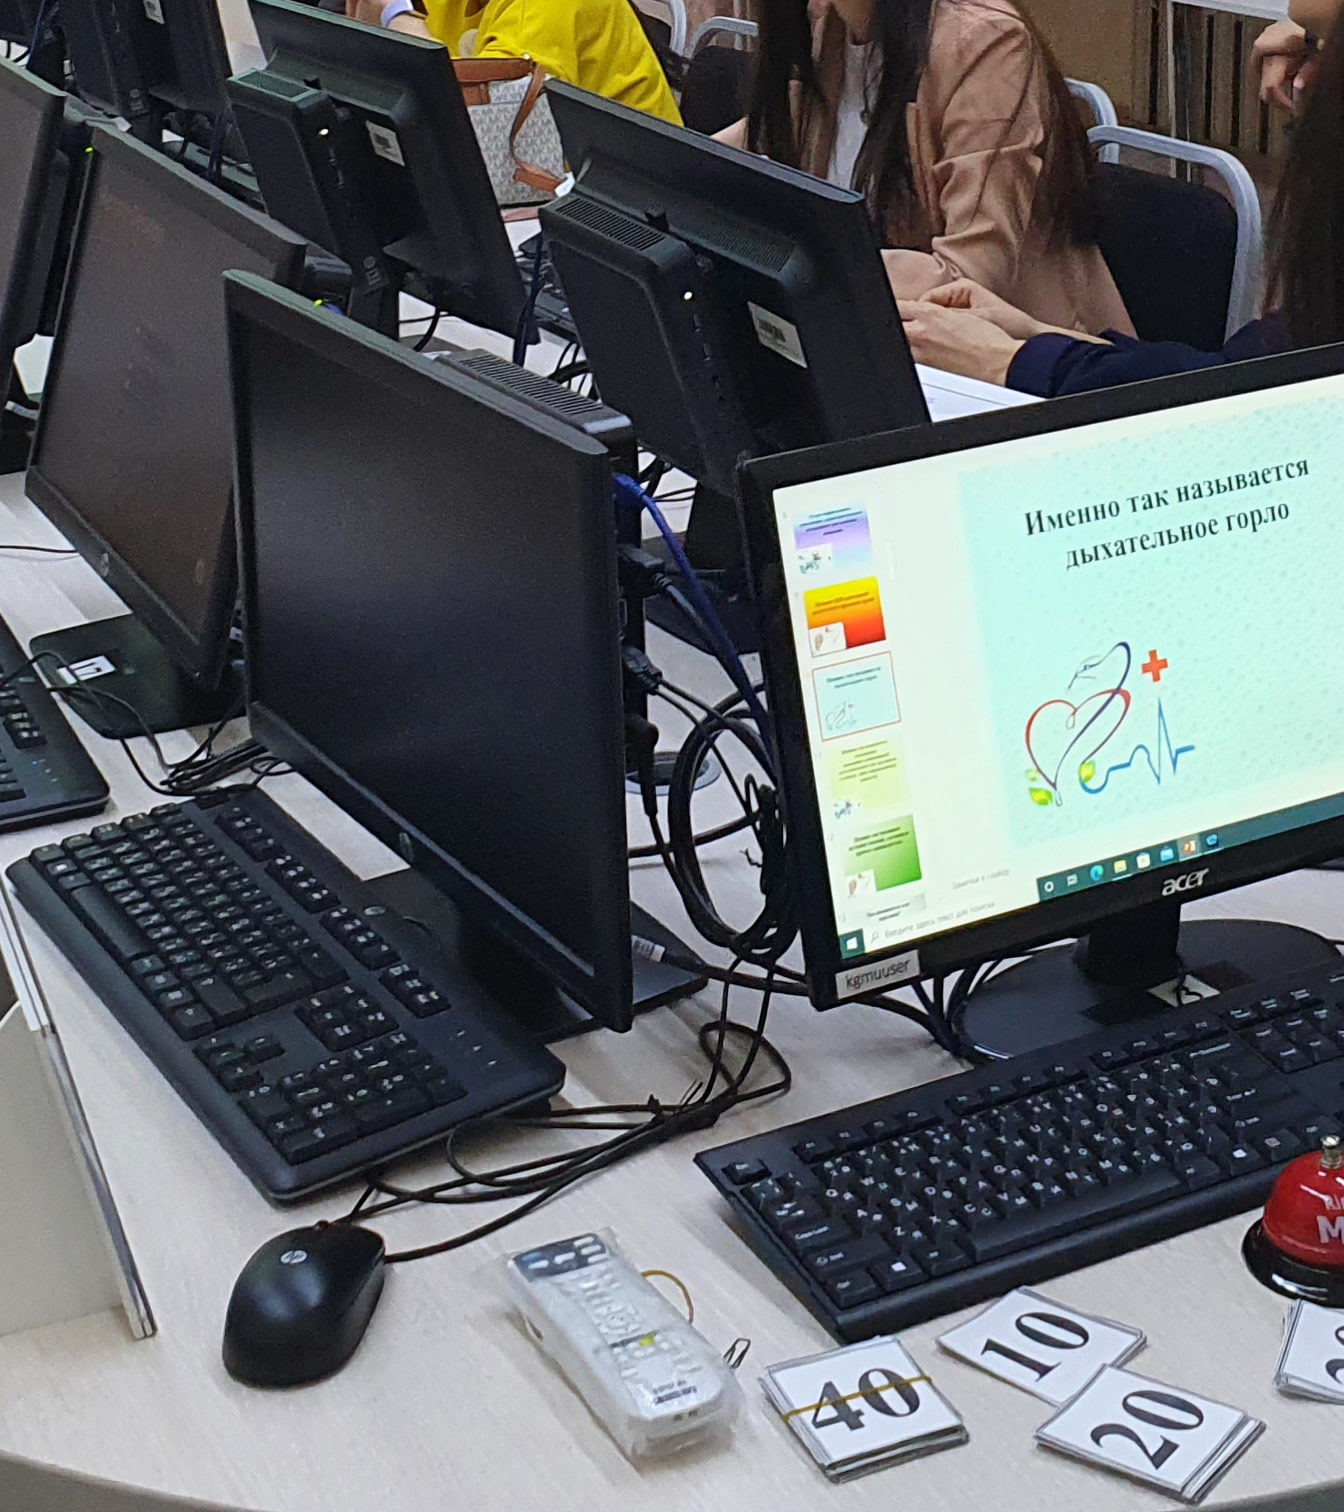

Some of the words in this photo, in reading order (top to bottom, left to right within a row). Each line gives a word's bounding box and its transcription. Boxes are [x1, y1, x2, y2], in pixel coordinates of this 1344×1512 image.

[1024, 500, 1121, 536] Именно
[1126, 488, 1170, 514] так
[1176, 459, 1310, 503] называется
[1066, 518, 1219, 571] дыхательное
[1225, 503, 1290, 532] горло
[1162, 868, 1210, 896] acer
[846, 960, 910, 988] kgmuuser
[980, 1311, 1090, 1383] 10
[810, 1367, 921, 1432] 40
[1089, 1389, 1205, 1471] 20
